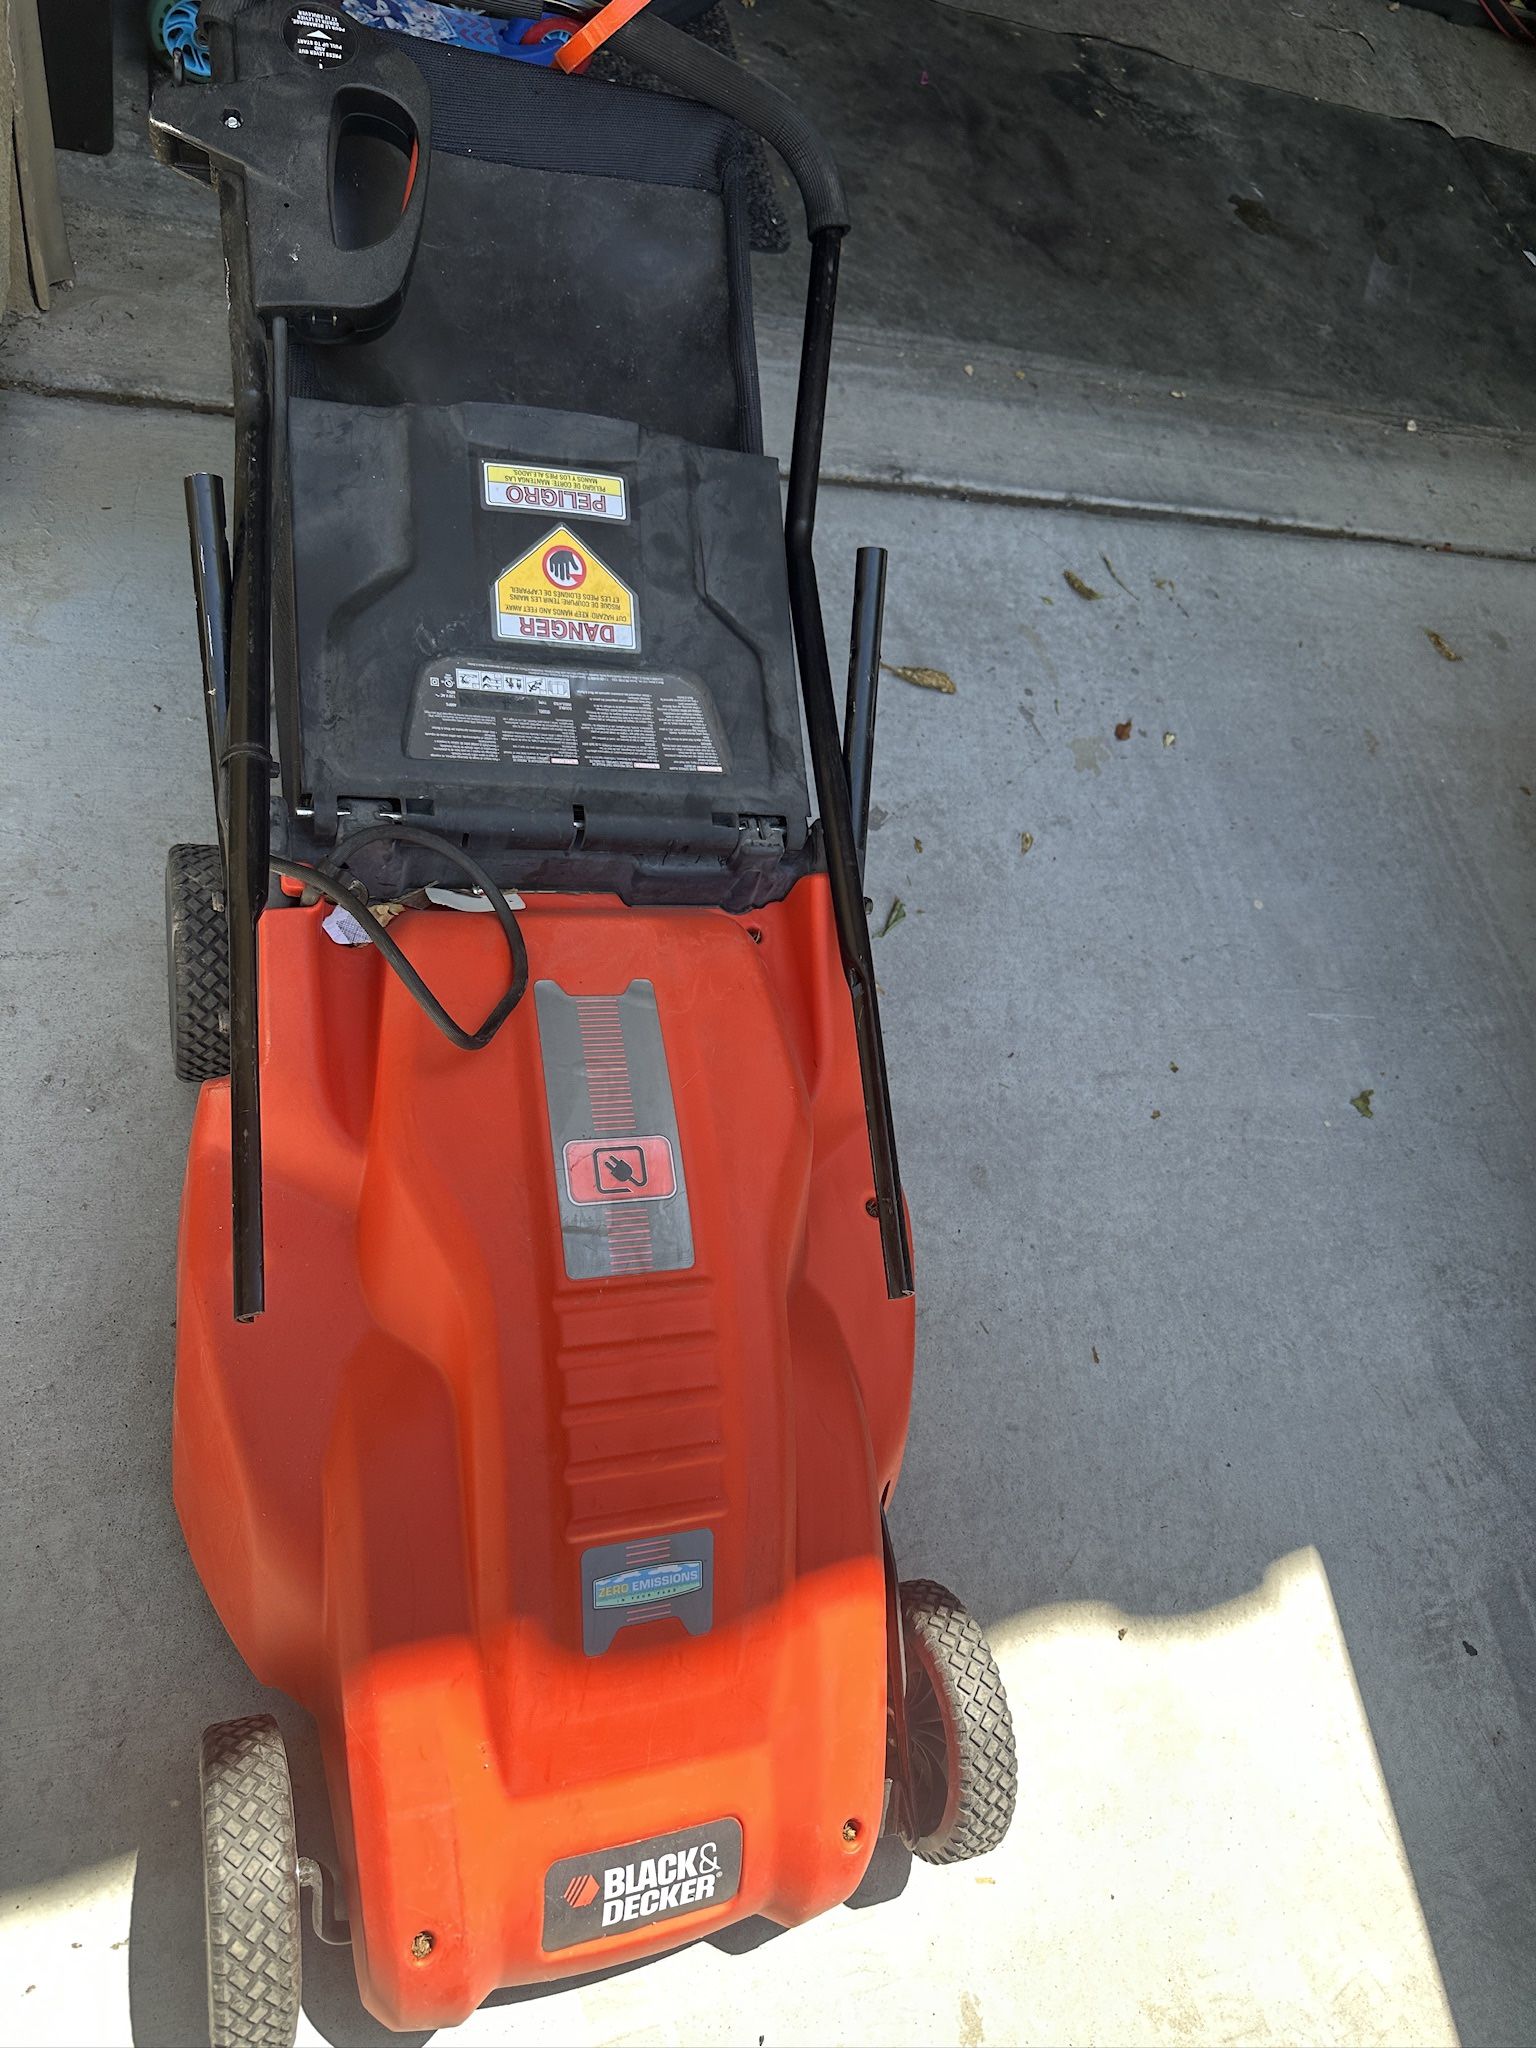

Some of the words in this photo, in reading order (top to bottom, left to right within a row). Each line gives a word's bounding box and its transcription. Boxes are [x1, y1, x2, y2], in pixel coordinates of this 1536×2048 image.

[517, 476, 550, 486] MANTENGA
[554, 481, 572, 489] CORTE:
[583, 484, 606, 492] PELIGRO
[506, 485, 606, 512] PELIGRO
[601, 602, 620, 610] RISQUE
[553, 609, 573, 617] HANDS
[519, 617, 615, 643] DANGER
[598, 1583, 629, 1598] ZERO
[632, 1570, 698, 1590] EMISSIONS
[602, 1874, 716, 1927] DECKER
